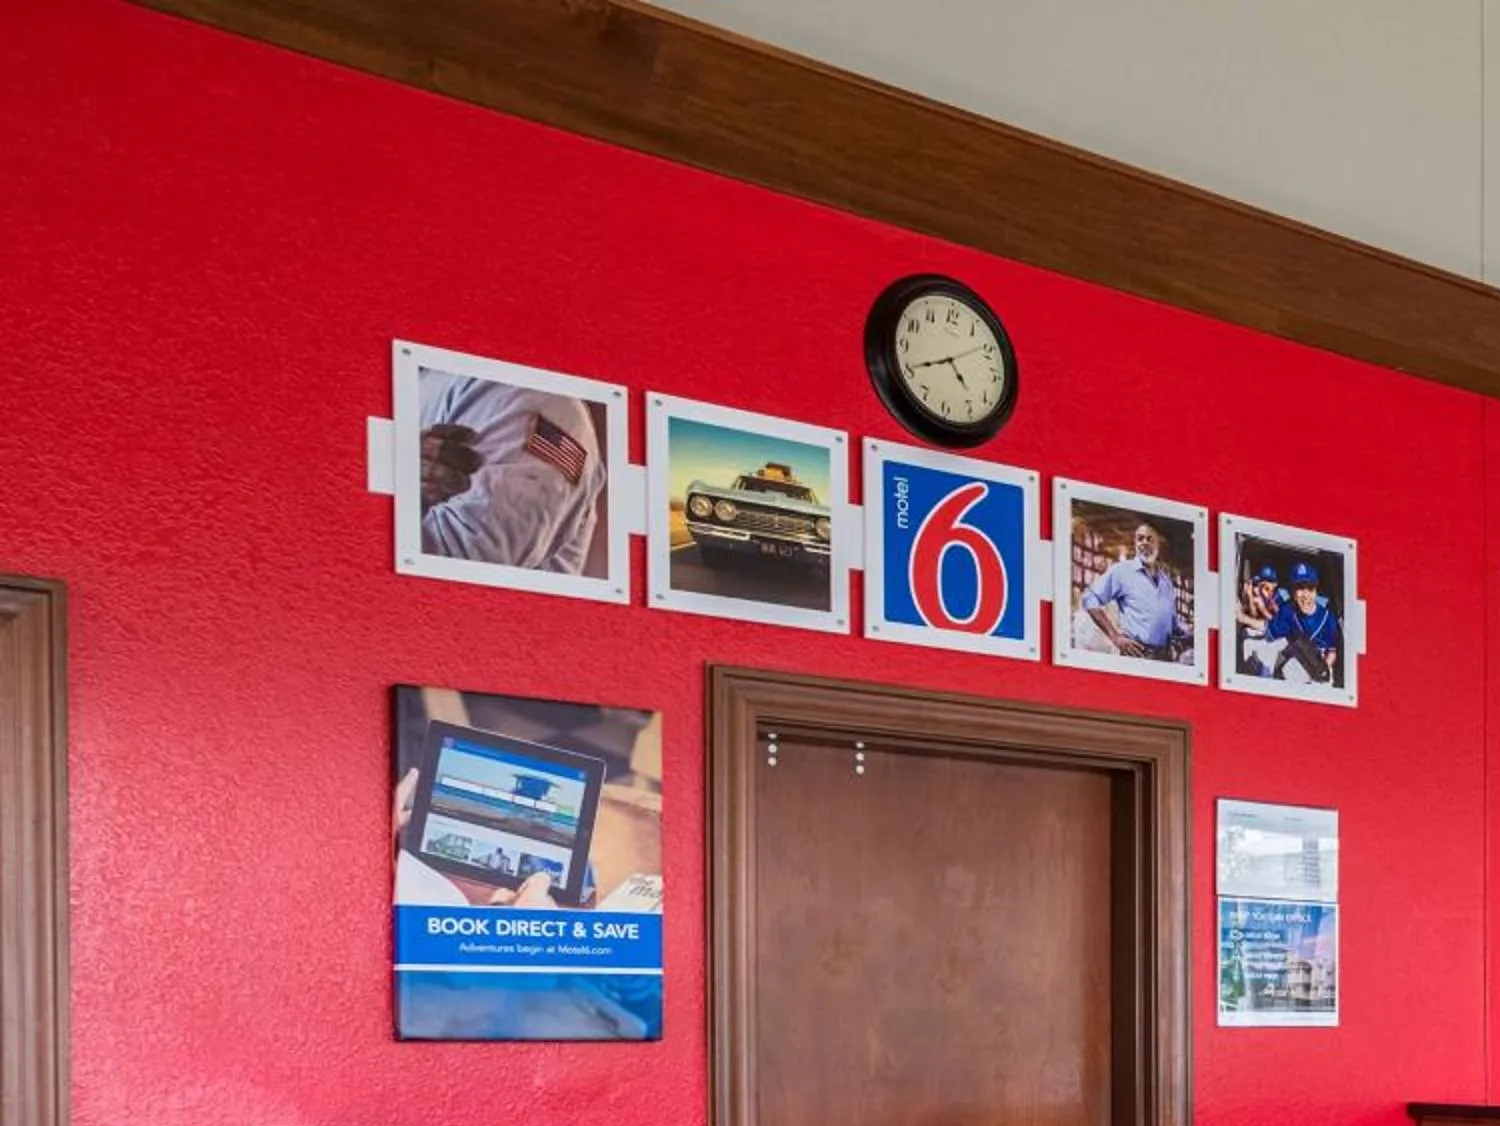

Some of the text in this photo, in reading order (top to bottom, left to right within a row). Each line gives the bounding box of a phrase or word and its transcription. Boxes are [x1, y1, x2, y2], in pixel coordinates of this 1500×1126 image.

[893, 476, 909, 529] motel
[908, 481, 1008, 637] 6
[427, 917, 640, 940] BOOK DIRECT & SAVE
[459, 942, 514, 953] Adventures
[516, 943, 544, 956] begin
[546, 945, 557, 954] at
